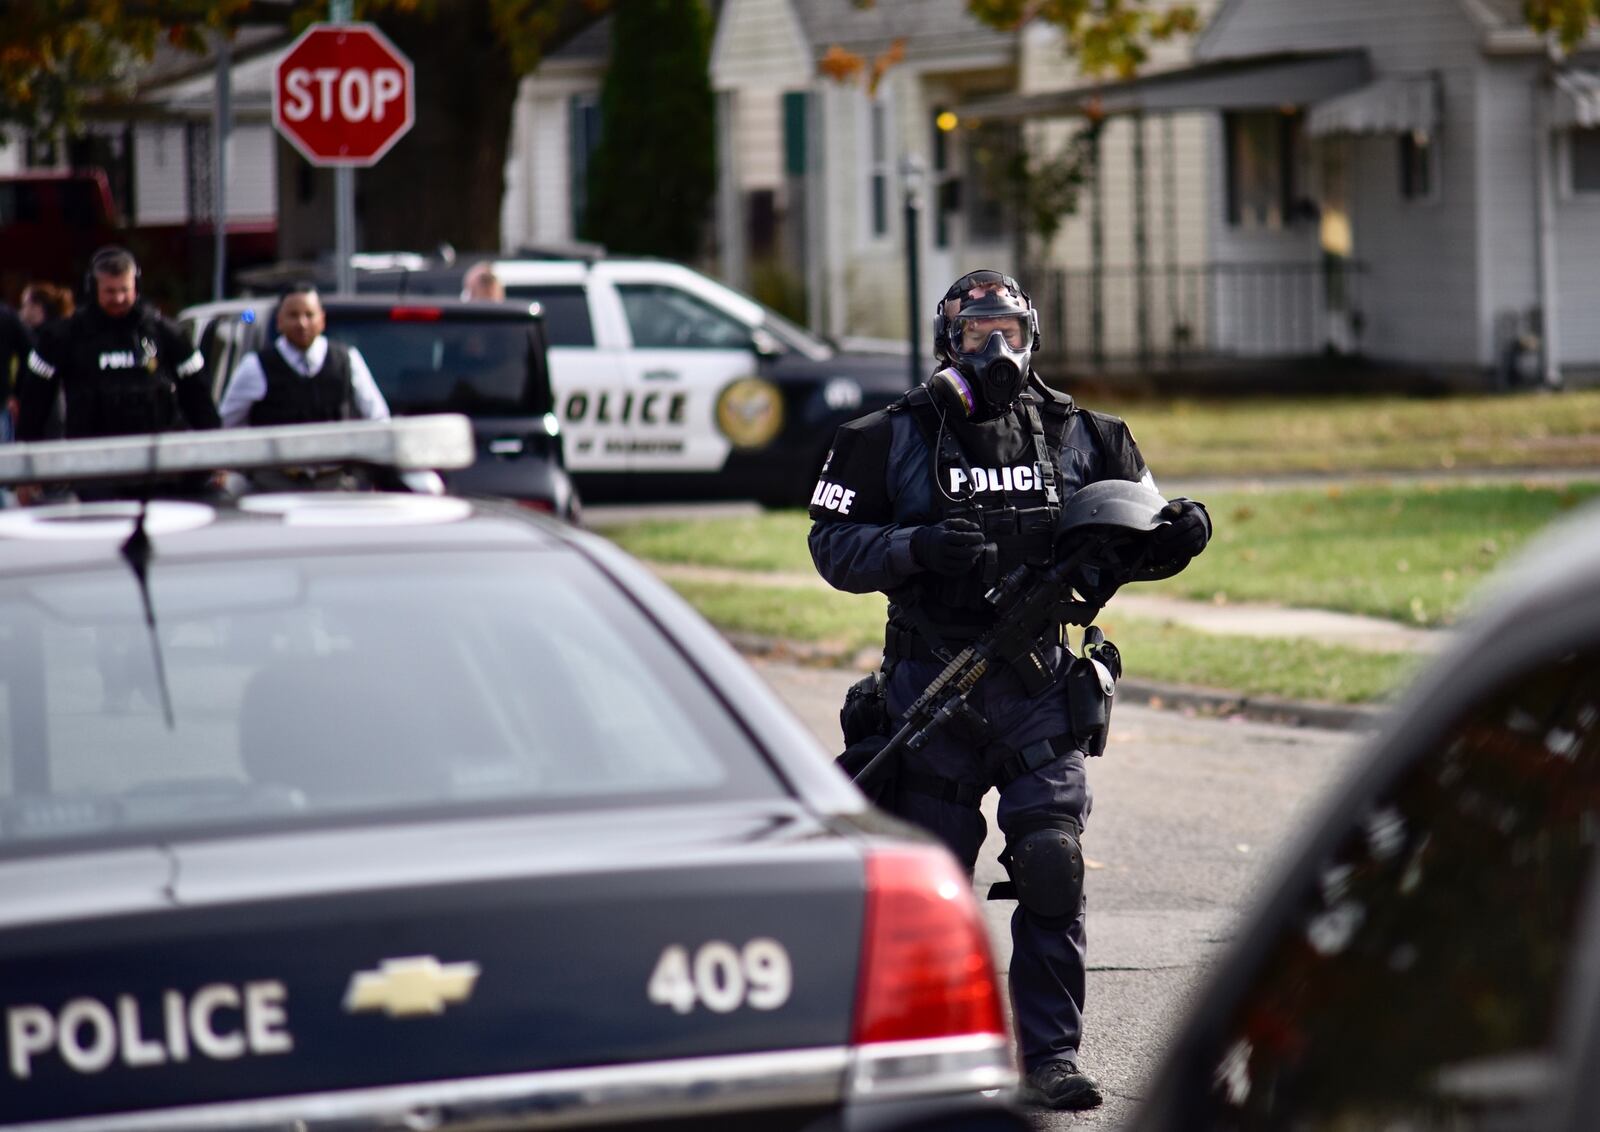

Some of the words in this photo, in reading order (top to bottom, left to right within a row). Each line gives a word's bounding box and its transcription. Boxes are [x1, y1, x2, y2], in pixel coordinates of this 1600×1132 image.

[284, 67, 402, 123] STOP
[565, 389, 687, 424] OLICE
[810, 480, 856, 515] LICE
[647, 937, 792, 1014] 409
[7, 980, 293, 1079] POLICE
